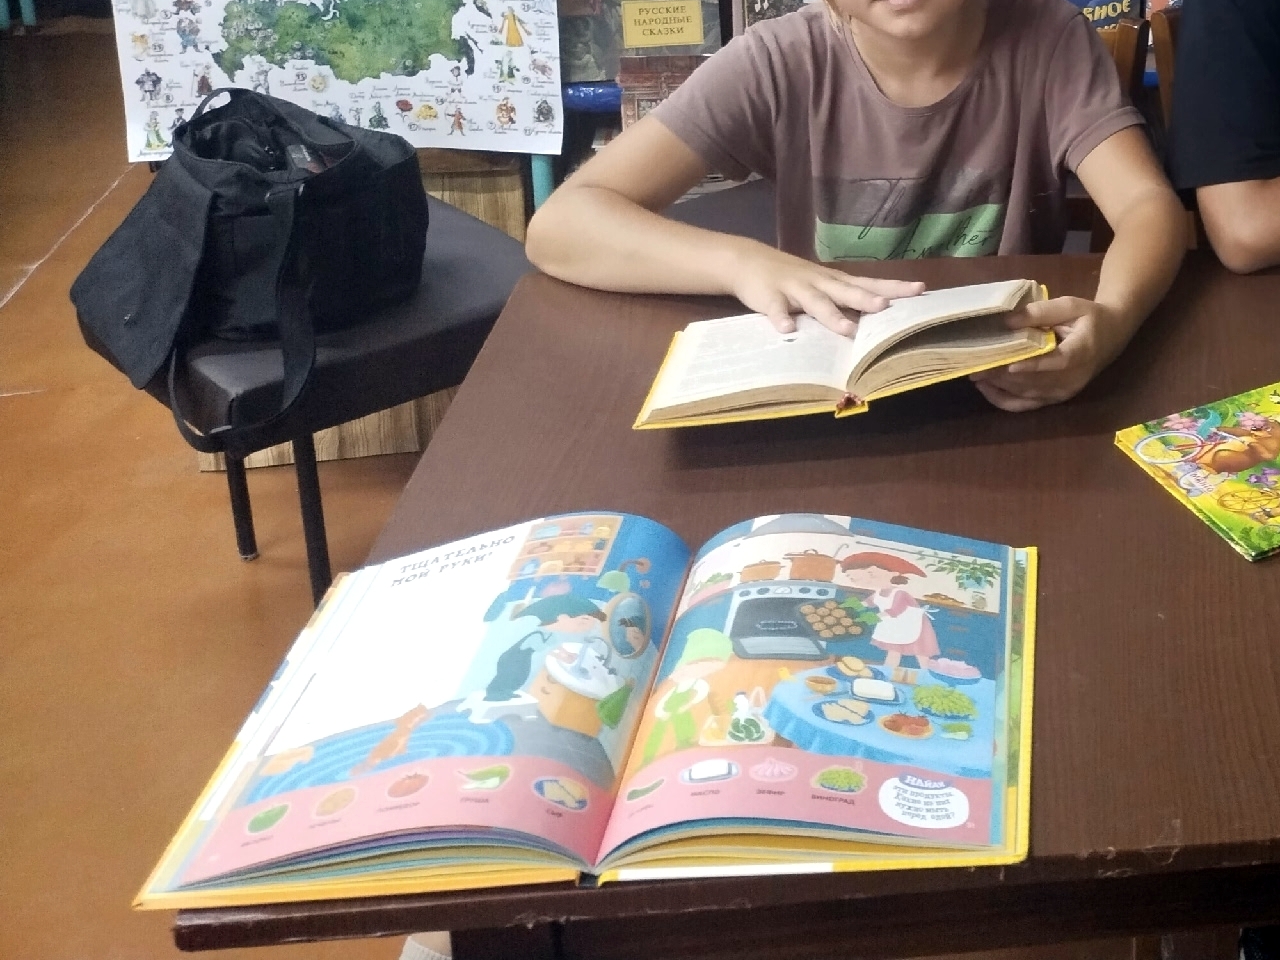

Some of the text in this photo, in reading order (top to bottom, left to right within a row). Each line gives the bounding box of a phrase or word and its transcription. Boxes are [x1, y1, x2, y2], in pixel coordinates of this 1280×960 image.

[638, 5, 686, 16] РУССКИЕ
[633, 15, 693, 28] НАРОДНЫЕ
[642, 26, 685, 37] СКАЗКИ
[401, 536, 515, 573] ТЩАТЕЛЬНО
[810, 794, 856, 807] ВИНОГРАД
